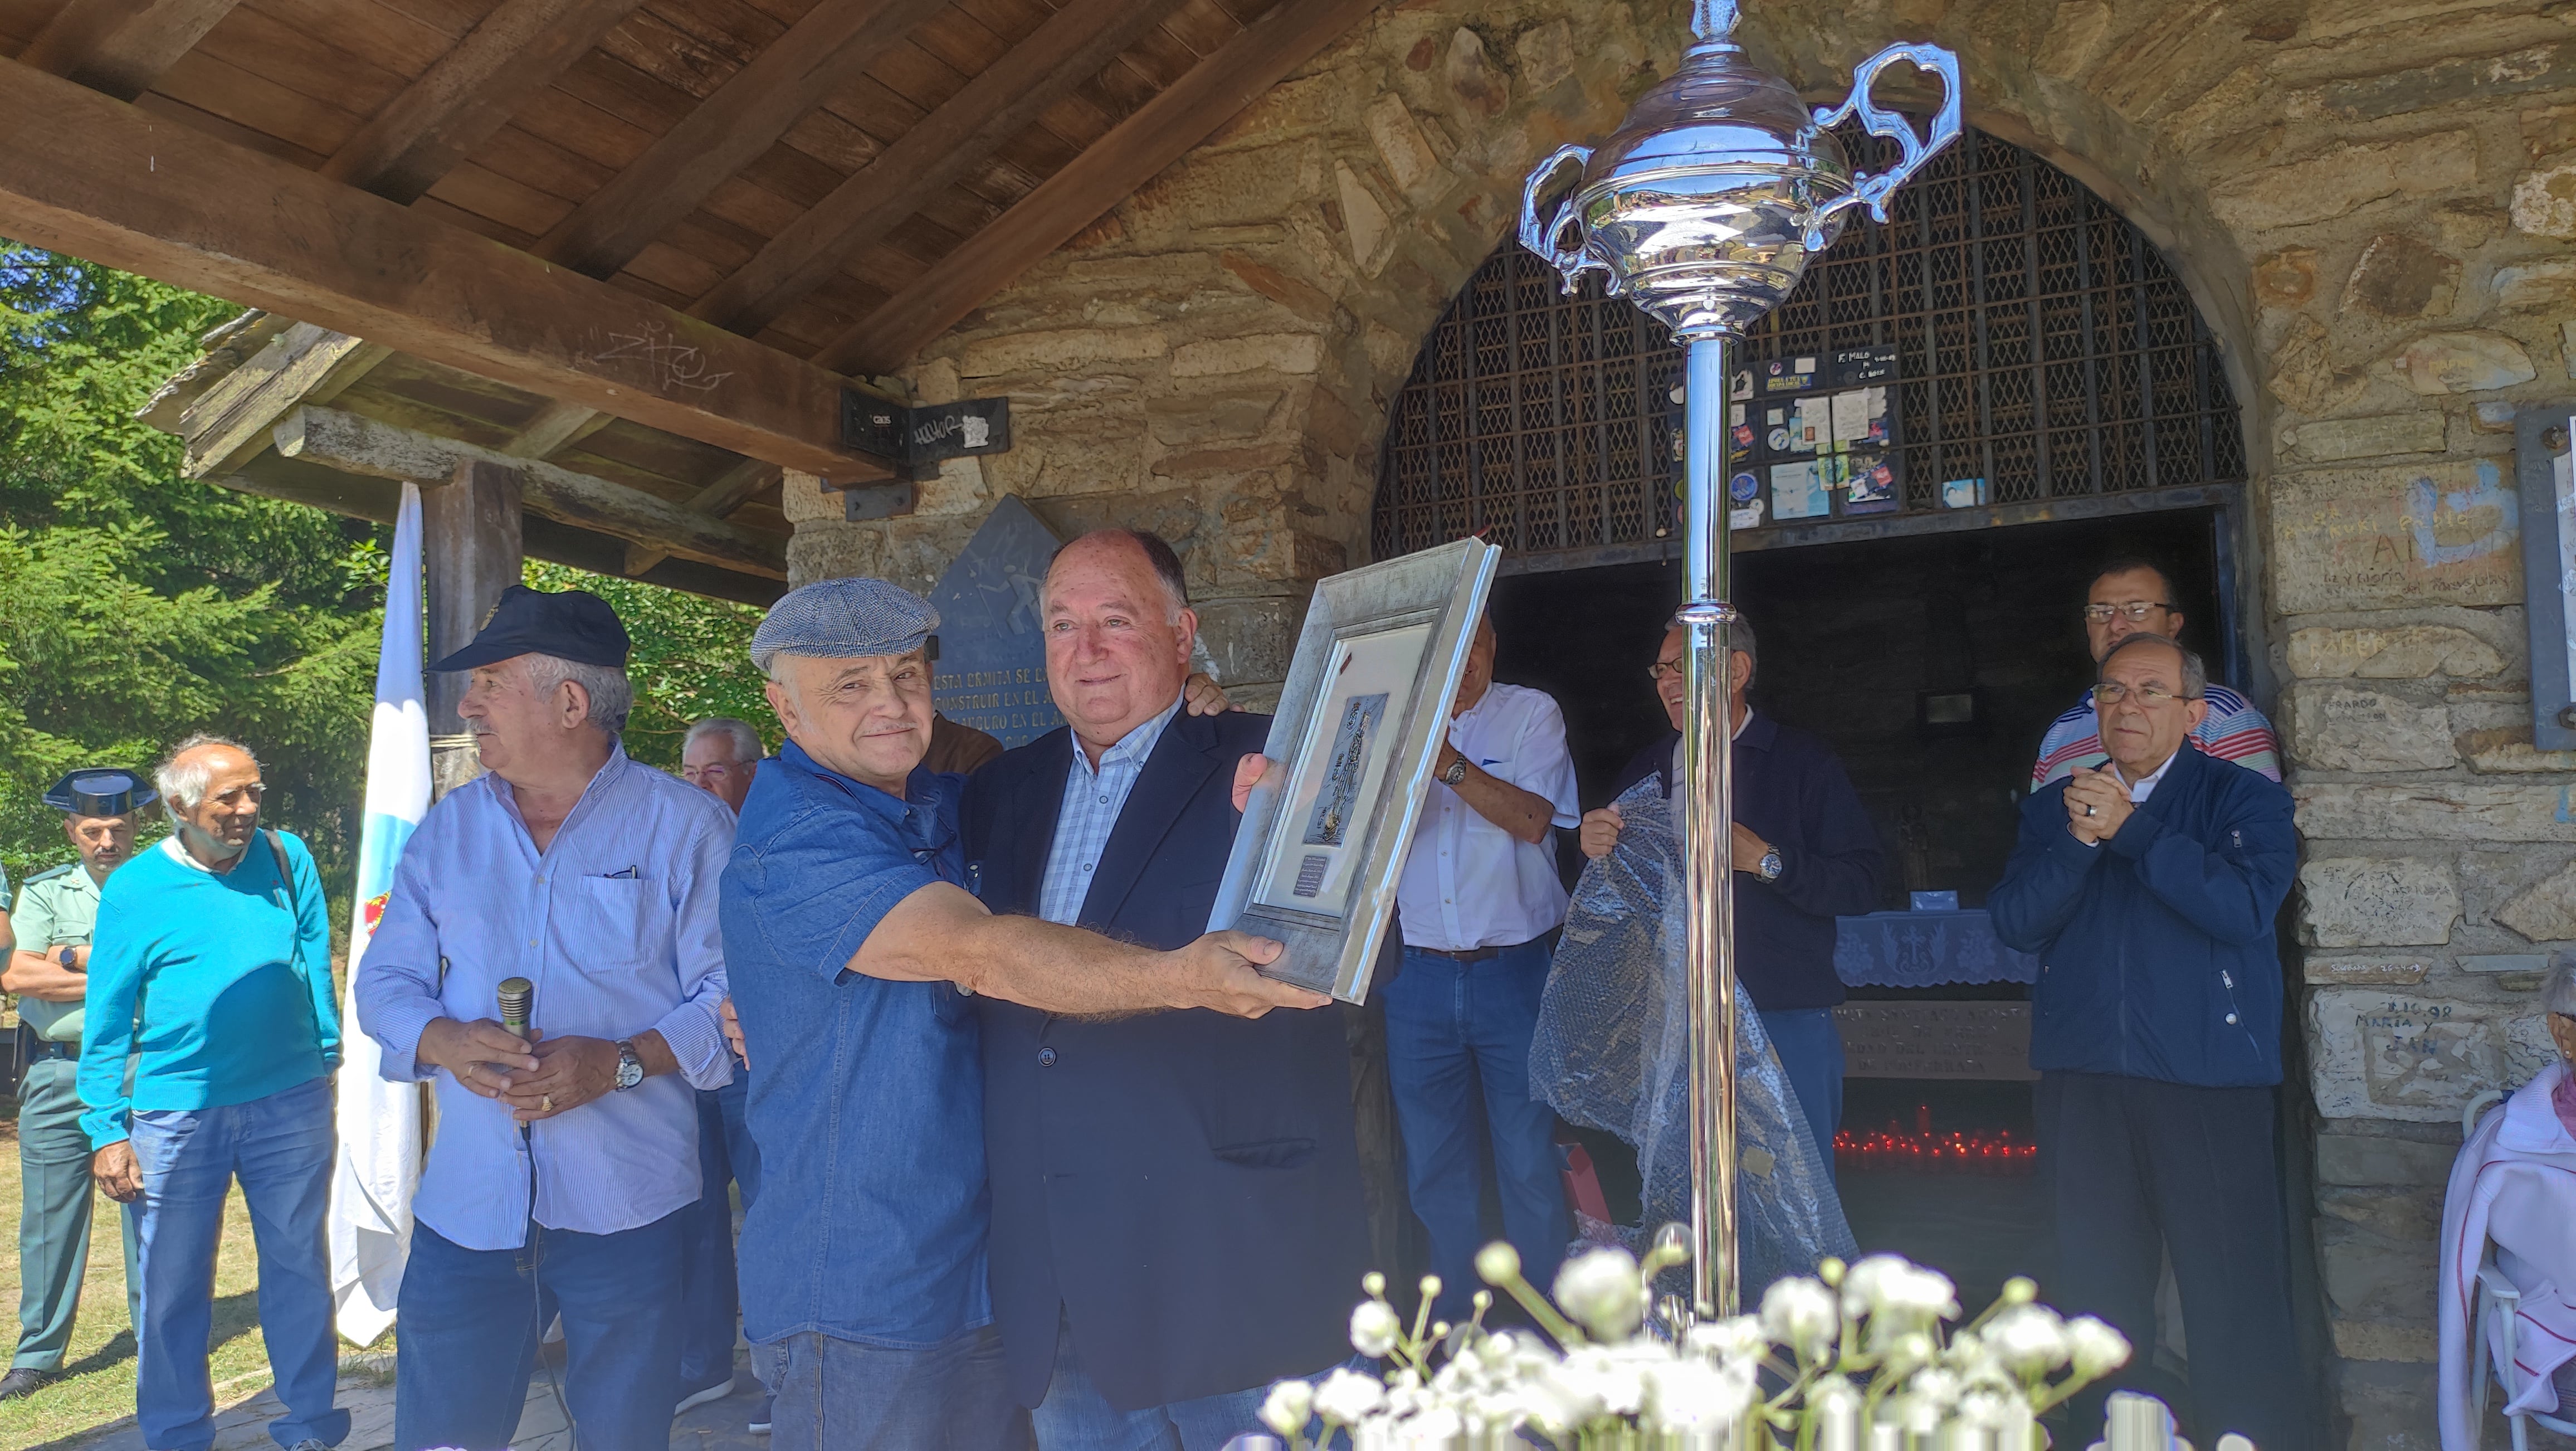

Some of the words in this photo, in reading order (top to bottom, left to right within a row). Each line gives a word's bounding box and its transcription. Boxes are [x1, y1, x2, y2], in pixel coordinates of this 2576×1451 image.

[933, 674, 963, 691] ESTA
[967, 670, 1012, 688] ERMITA
[1016, 668, 1031, 684] SE
[934, 692, 1000, 712] CONSTRUIR
[1004, 691, 1019, 707] EN
[1024, 690, 1039, 705] EL
[1012, 713, 1027, 729] EN
[1032, 711, 1046, 727] EL
